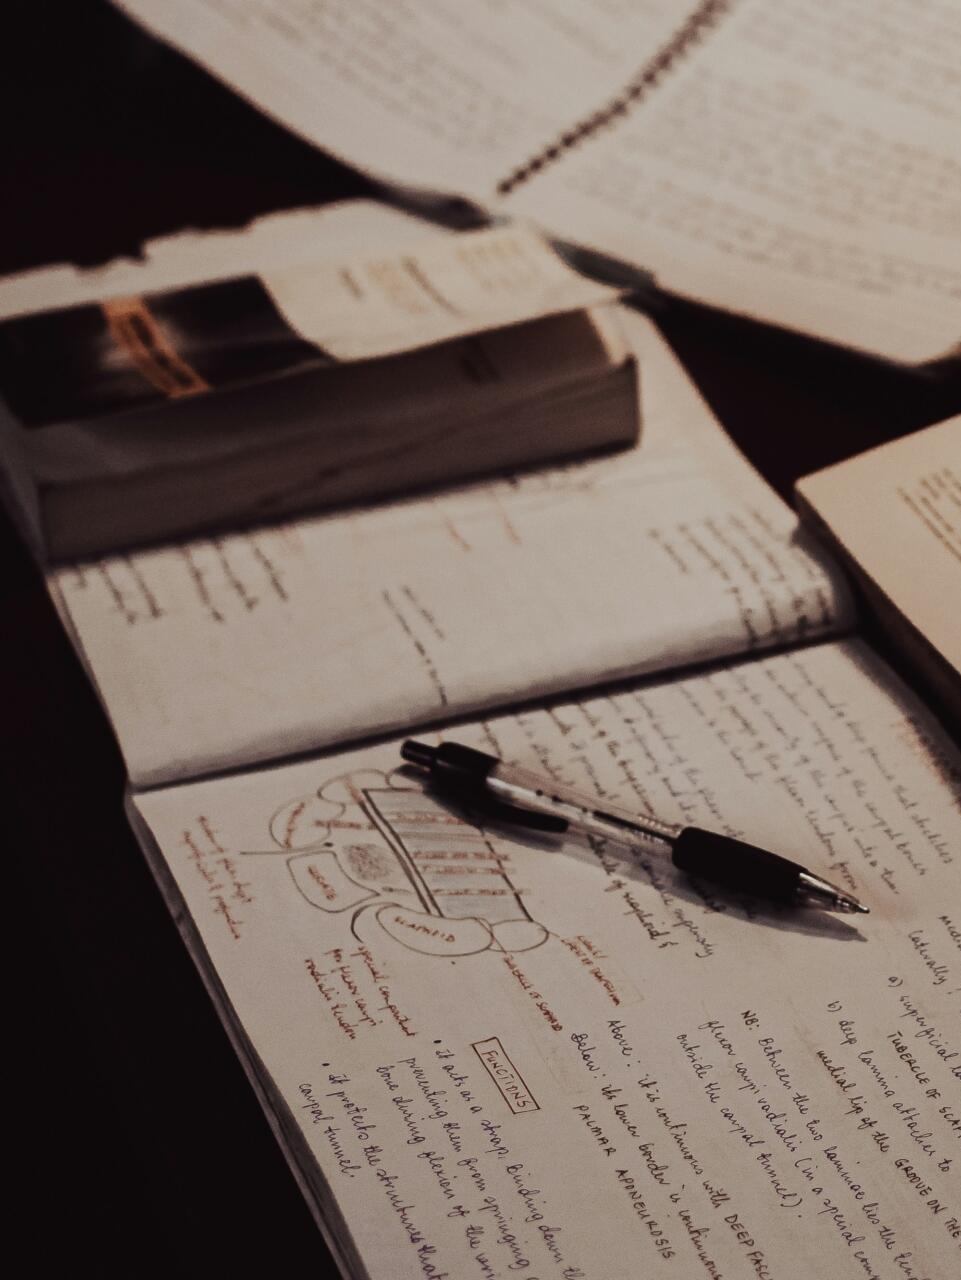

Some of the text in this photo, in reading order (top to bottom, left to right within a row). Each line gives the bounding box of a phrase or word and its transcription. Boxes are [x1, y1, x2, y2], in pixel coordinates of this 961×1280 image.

[697, 1020, 737, 1056] flexor
[887, 976, 904, 988] a)
[899, 995, 959, 1062] superficial
[887, 1030, 931, 1085] TUBERCLE
[925, 1088, 941, 1100] OF
[481, 1049, 531, 1108] FUNCTIONS
[676, 1034, 714, 1080] outside
[704, 1082, 721, 1104] the
[719, 1107, 766, 1148] carpal
[734, 1062, 768, 1095] carpi
[757, 1097, 803, 1153] radialis
[827, 1000, 953, 1173] b) deep lamina attaches to
[298, 1083, 362, 1178] carpal tunnel.
[391, 1057, 531, 1271] preventing them from springing
[391, 1095, 426, 1145] during
[416, 1151, 458, 1200] flexion
[446, 1204, 471, 1218] of
[465, 1224, 485, 1250] the
[441, 1064, 469, 1088] acts
[459, 1090, 475, 1102] as
[469, 1105, 481, 1114] a
[537, 1225, 564, 1264] down
[613, 1103, 641, 1138] lower
[669, 1183, 686, 1204] is
[655, 1106, 704, 1176] continuous
[702, 1180, 731, 1209] with
[723, 1213, 755, 1247] DEEP
[758, 1037, 792, 1090] Between
[791, 1092, 810, 1115] the
[805, 1119, 823, 1141] two
[822, 1145, 866, 1201] laminae
[861, 1202, 881, 1225] lies
[877, 1225, 896, 1250] the
[815, 1050, 857, 1093] medial
[844, 1095, 868, 1115] lip
[871, 1130, 890, 1153] the
[894, 1158, 933, 1197] GROOVE
[926, 1199, 948, 1215] ON
[363, 1144, 384, 1167] the
[375, 1167, 426, 1244] structures
[572, 1104, 676, 1260] PALMAR APONEUROSIS
[811, 1187, 824, 1196] a
[817, 1198, 866, 1247] special
